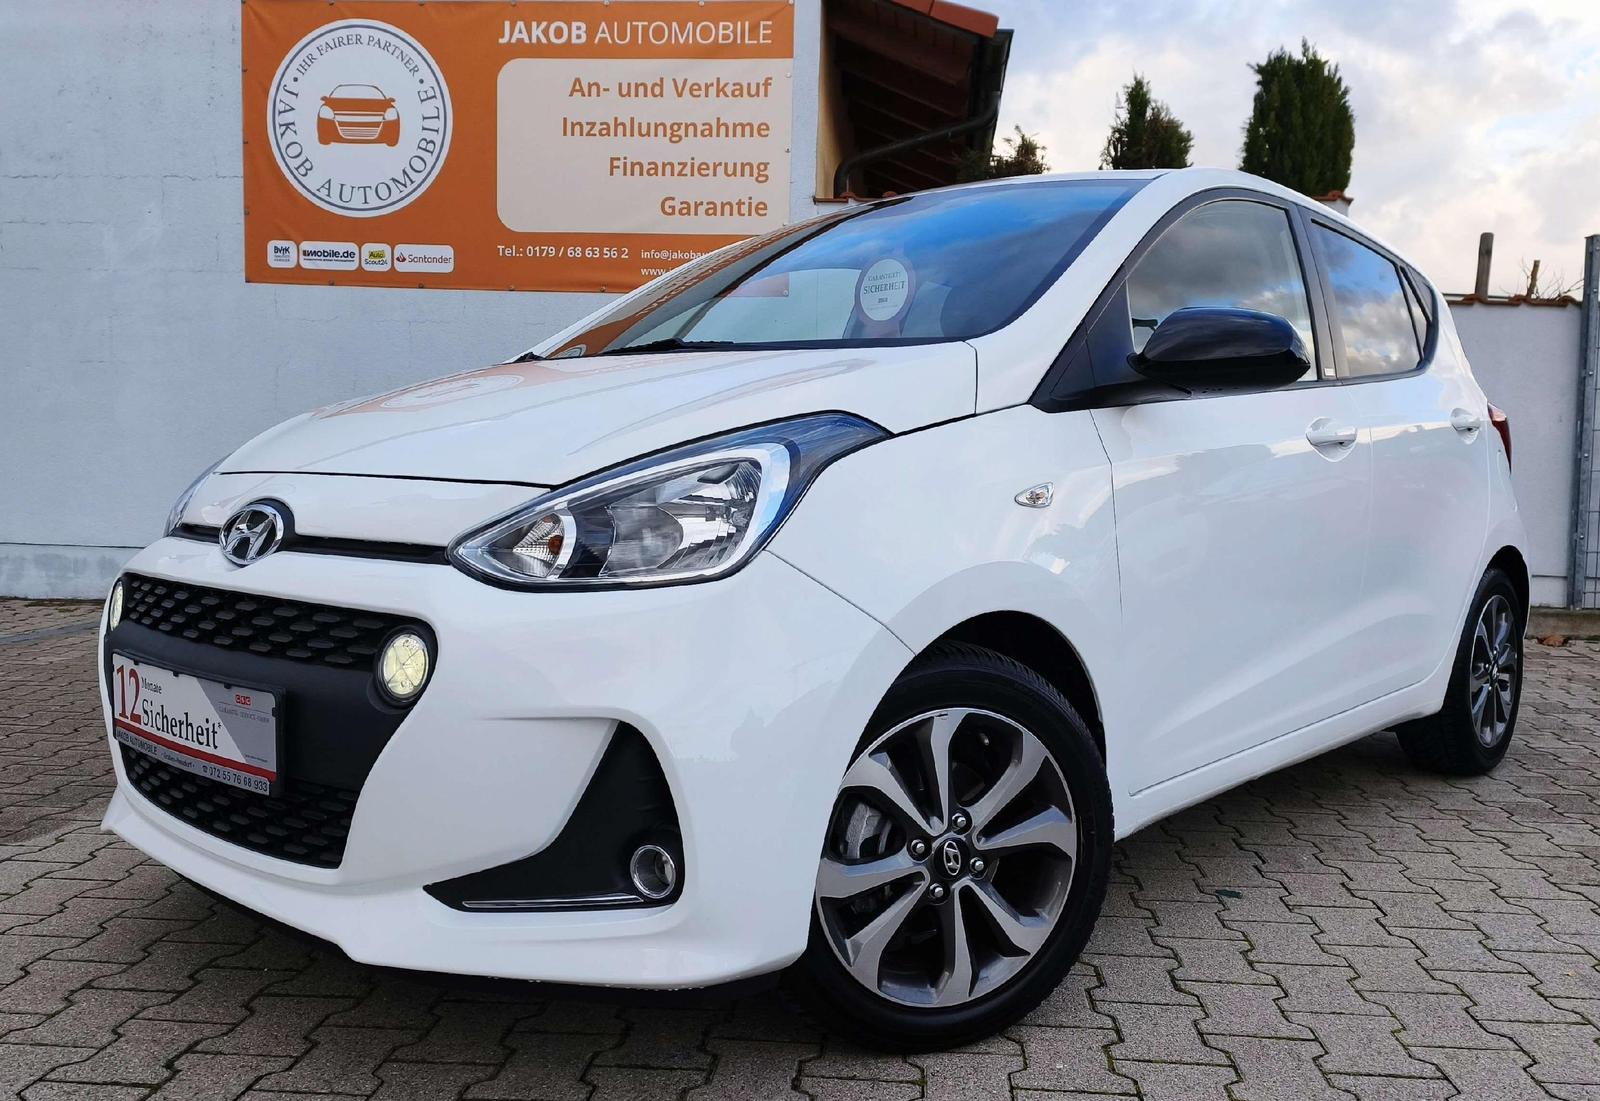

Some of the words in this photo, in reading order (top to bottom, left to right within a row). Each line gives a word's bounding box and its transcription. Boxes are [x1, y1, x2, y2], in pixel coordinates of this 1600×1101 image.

[498, 21, 587, 44] JAKOB
[594, 21, 773, 45] AUTOMOBILE
[296, 53, 317, 76] IHR
[316, 33, 364, 56] FAIRER
[367, 34, 420, 77] PARTNER
[568, 77, 610, 98] An-
[618, 77, 665, 98] und
[672, 77, 773, 98] Verkauf
[562, 116, 770, 144] Inzahlungnahme
[277, 84, 314, 178] JAKOB
[316, 85, 440, 204] AUTOMOBILE
[609, 156, 770, 184] Finanzierung
[660, 196, 769, 217] Garantie
[307, 249, 356, 259] mobile.de
[408, 254, 452, 264] Santander
[497, 245, 523, 257] Tel.:
[526, 245, 556, 257] 0179
[567, 246, 582, 258] 68
[585, 246, 600, 258] 63
[603, 247, 618, 259] 56
[621, 247, 629, 259] 2
[863, 281, 905, 295] SICHERHEIT
[116, 664, 142, 726] 12
[141, 676, 162, 695] Monate
[222, 770, 231, 781] 55
[253, 779, 268, 792] 933
